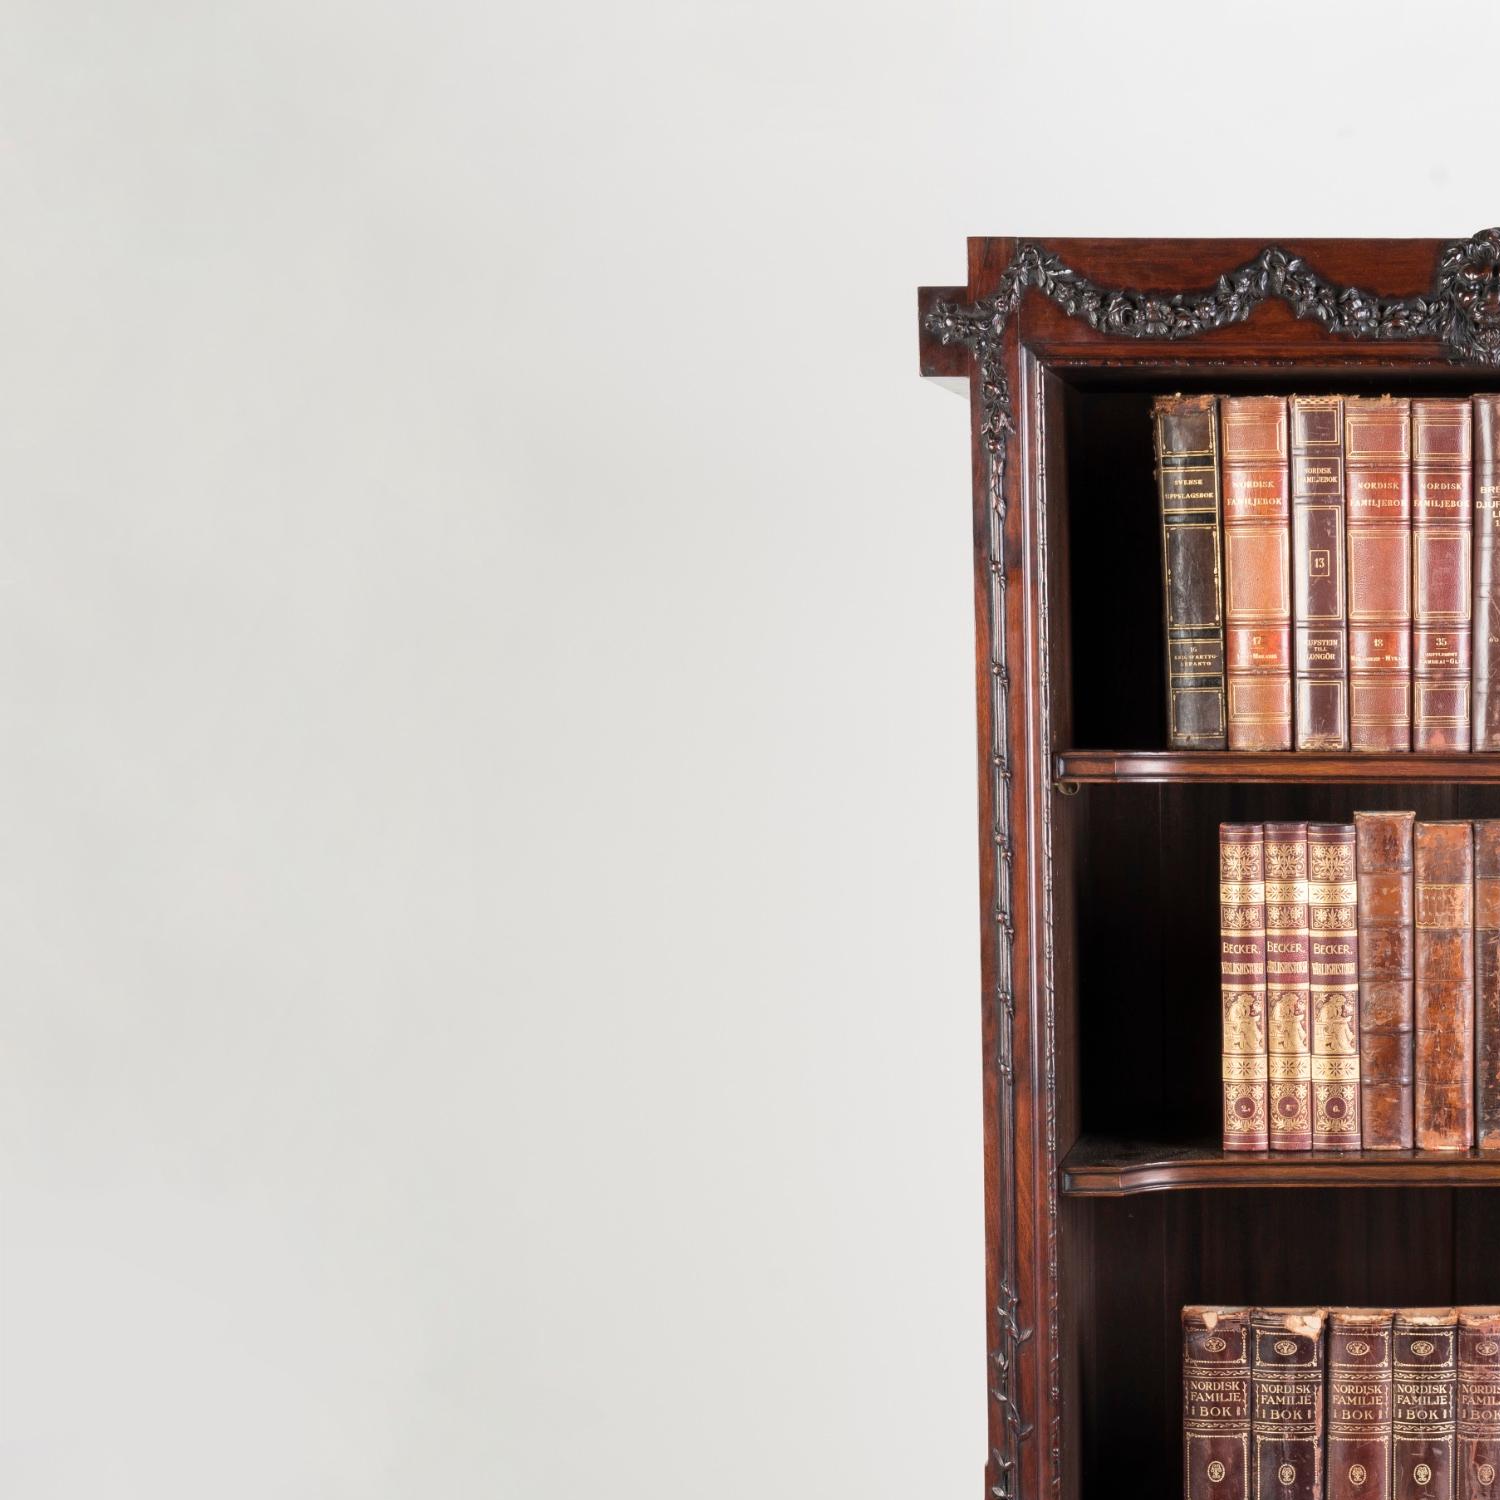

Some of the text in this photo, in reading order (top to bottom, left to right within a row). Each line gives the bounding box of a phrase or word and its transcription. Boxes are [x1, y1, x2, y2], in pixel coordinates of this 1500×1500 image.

[1232, 480, 1275, 488] NORDISK
[1358, 482, 1399, 490] NORDISK
[1420, 482, 1462, 490] NORDISK
[1227, 498, 1282, 506] FAMILJEBOK
[1413, 500, 1469, 508] FAMILJEBOK
[1314, 557, 1325, 569] 13
[1435, 637, 1447, 646] 35
[1222, 941, 1261, 954] BECKER,
[1313, 943, 1353, 955] BECKER,
[1191, 1381, 1240, 1391] NORDISK
[1261, 1383, 1311, 1394] NORDISK
[1333, 1383, 1383, 1394] NORDISK
[1397, 1383, 1447, 1394] NORDISK
[1190, 1392, 1241, 1402] FAMILJE
[1261, 1395, 1312, 1405] FAMILJE
[1332, 1395, 1383, 1405] FAMILJE
[1397, 1395, 1448, 1405] FAMILJE
[1200, 1406, 1232, 1417] BOK
[1270, 1409, 1303, 1420] BOK
[1342, 1409, 1374, 1420] BOK
[1406, 1409, 1440, 1420] BOK
